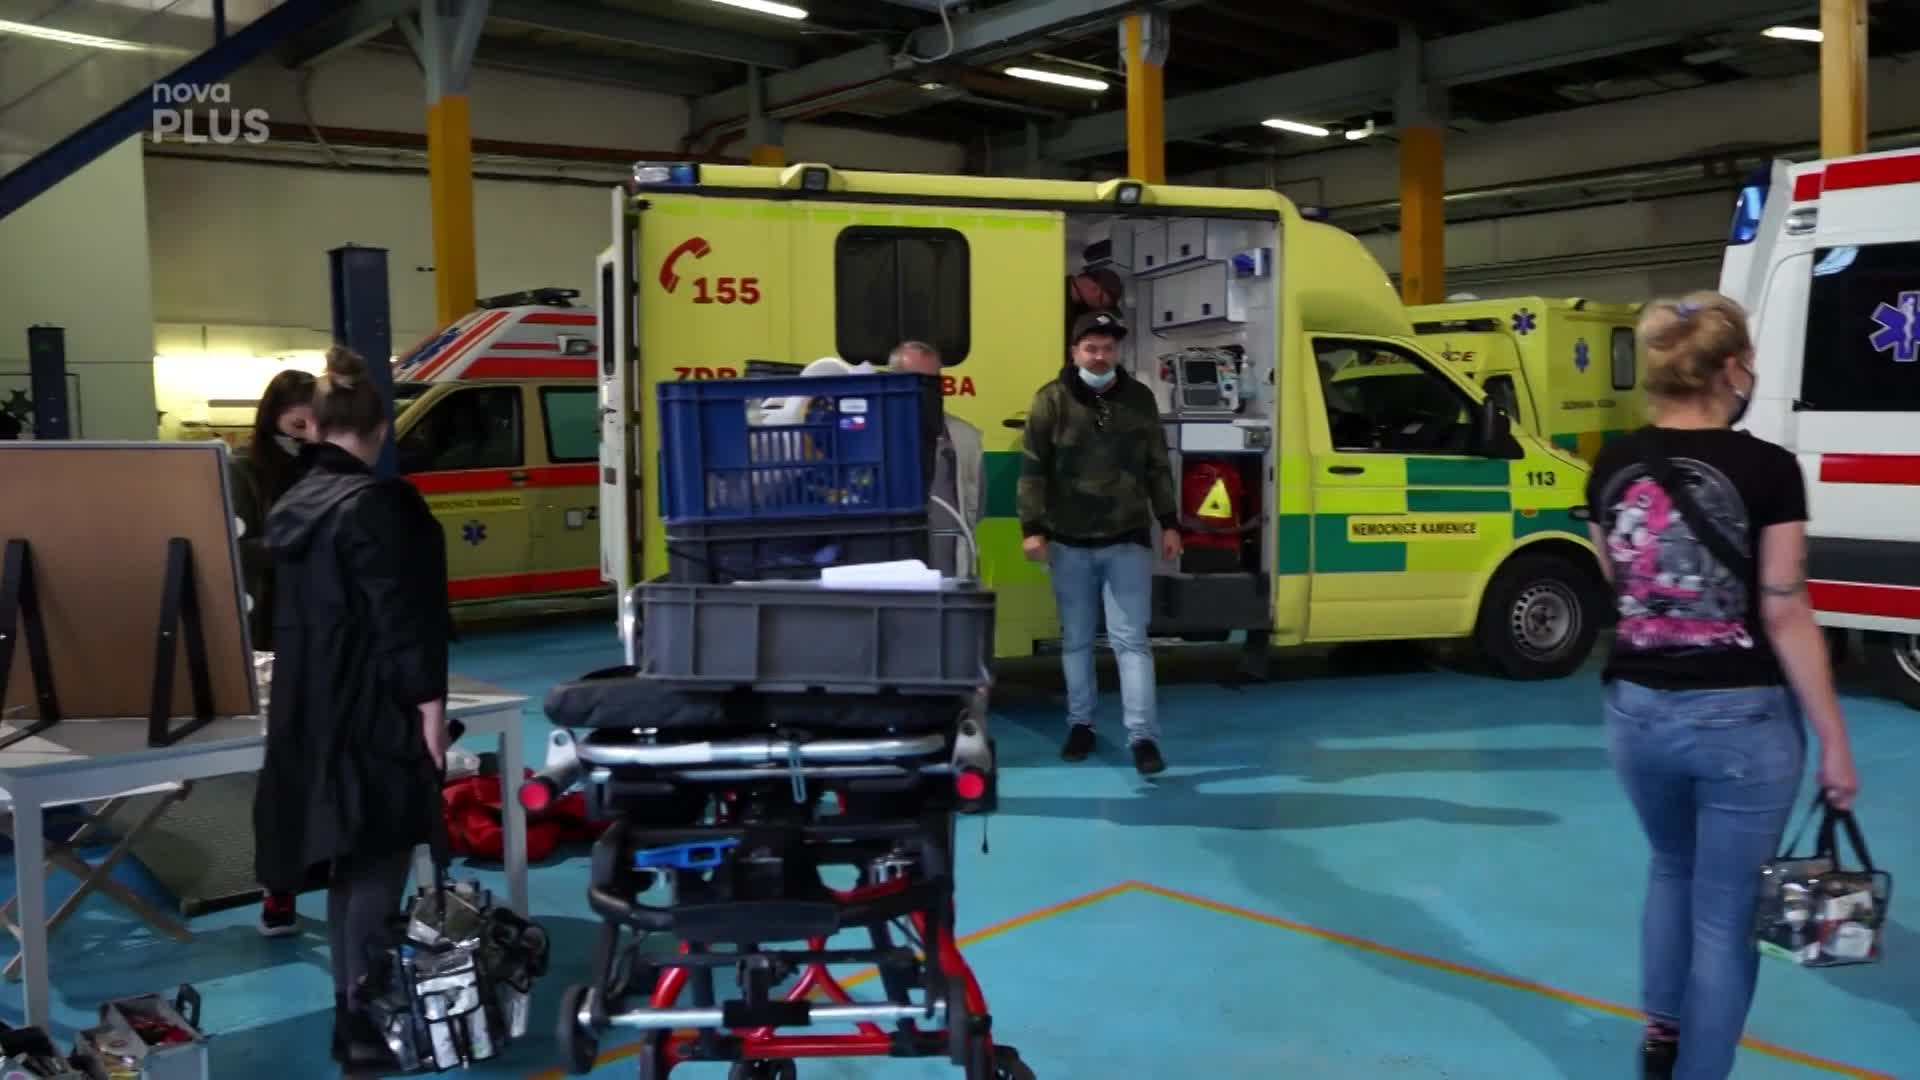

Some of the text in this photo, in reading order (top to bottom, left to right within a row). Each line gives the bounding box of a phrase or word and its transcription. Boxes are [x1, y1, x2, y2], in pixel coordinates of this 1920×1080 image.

[692, 277, 760, 304] 155
[1526, 471, 1555, 486] 113
[1352, 523, 1417, 535] NEMOCNICE
